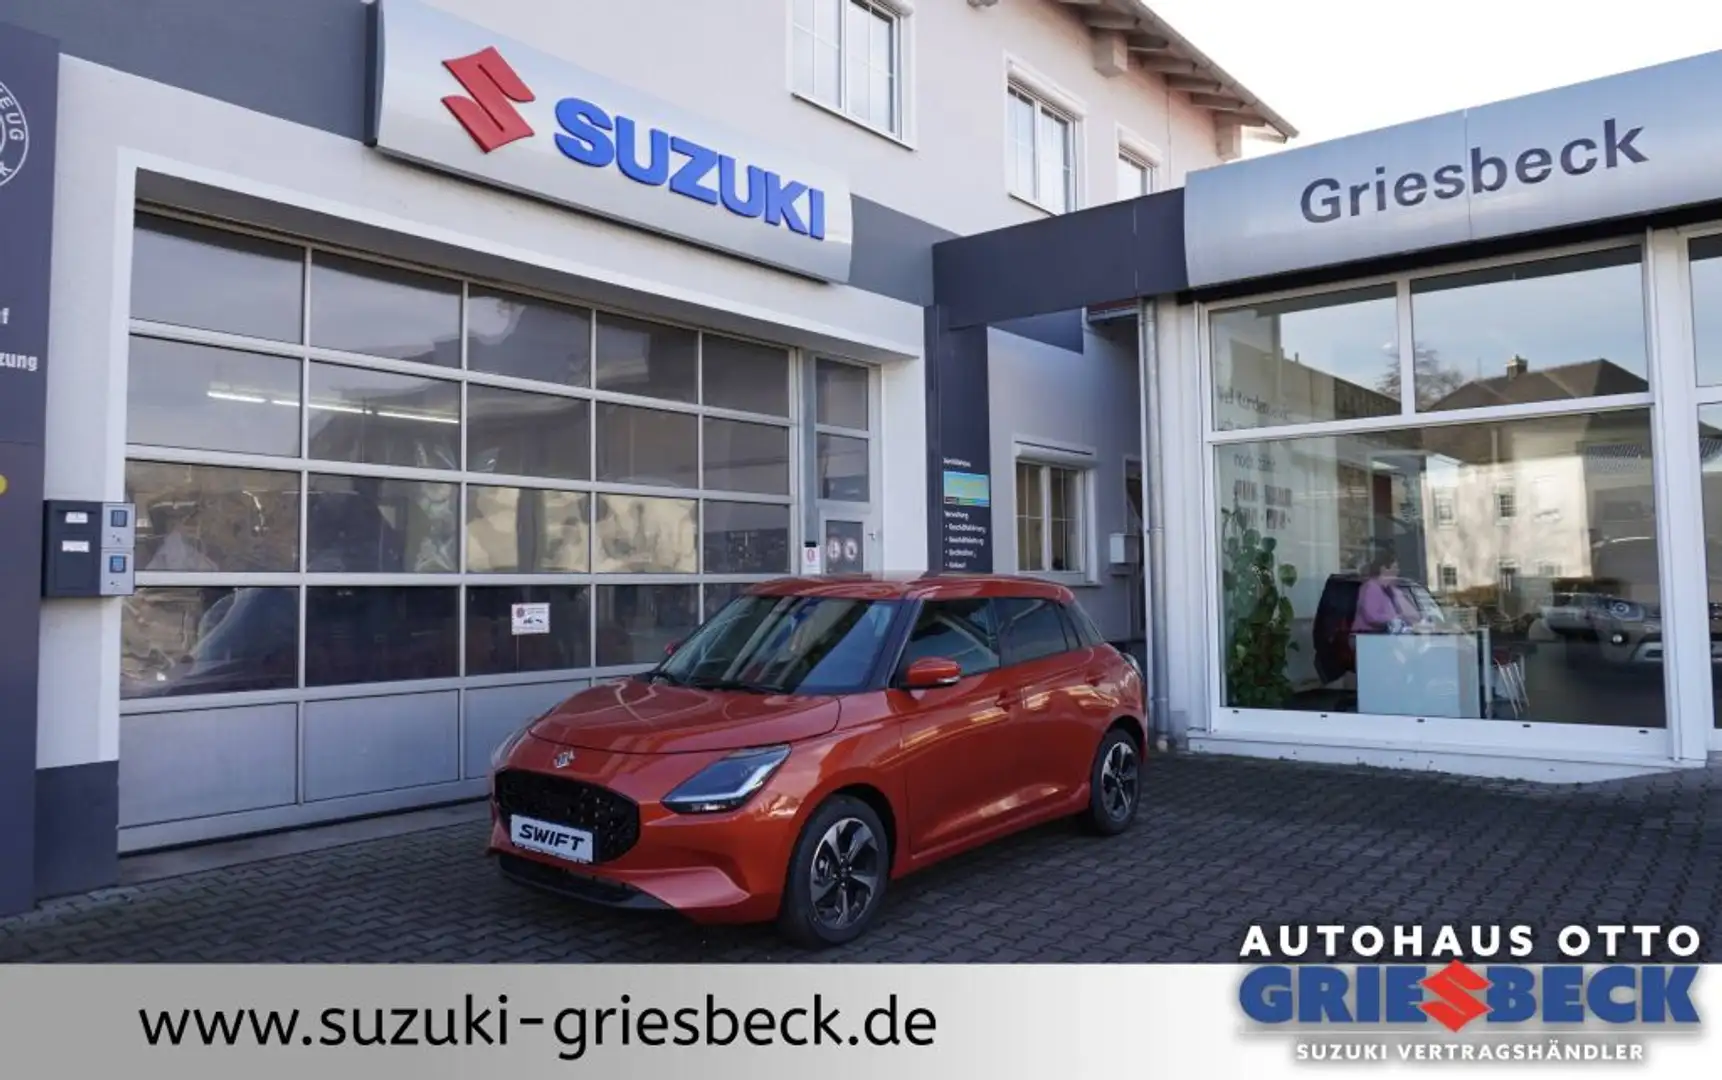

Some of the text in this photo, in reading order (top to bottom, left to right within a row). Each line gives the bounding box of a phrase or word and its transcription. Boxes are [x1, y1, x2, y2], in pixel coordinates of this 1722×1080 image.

[554, 97, 825, 240] SUZUKI
[1301, 118, 1649, 224] Griesbeck
[519, 824, 585, 851] SWIFT
